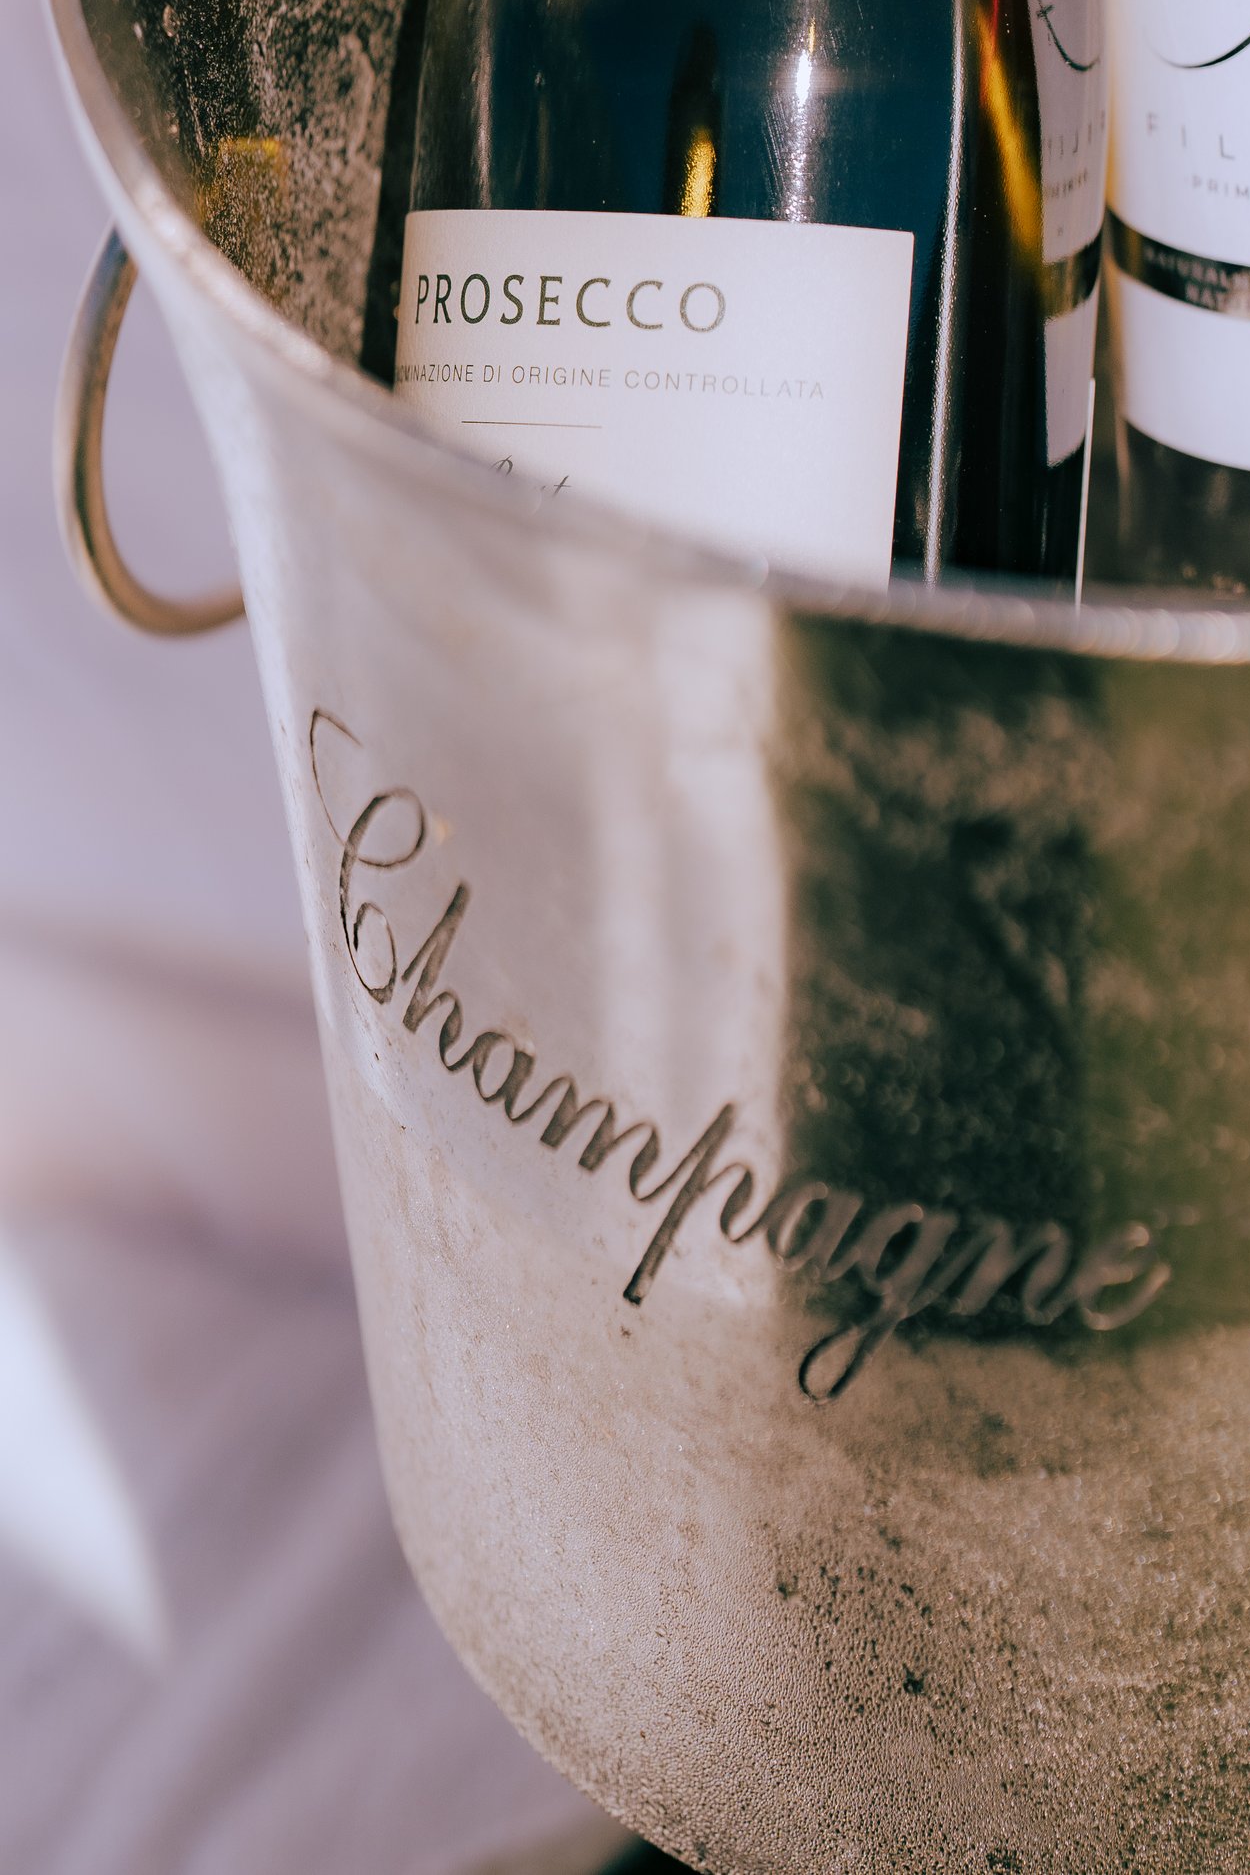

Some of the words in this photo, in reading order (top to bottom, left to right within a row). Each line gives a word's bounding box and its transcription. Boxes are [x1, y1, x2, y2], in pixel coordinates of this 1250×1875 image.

[414, 273, 727, 333] PROSECCO
[483, 364, 501, 383] DI
[512, 364, 611, 389] ORIGINE
[624, 370, 825, 400] CONTROLLATA
[309, 707, 1171, 1404] Champagne
